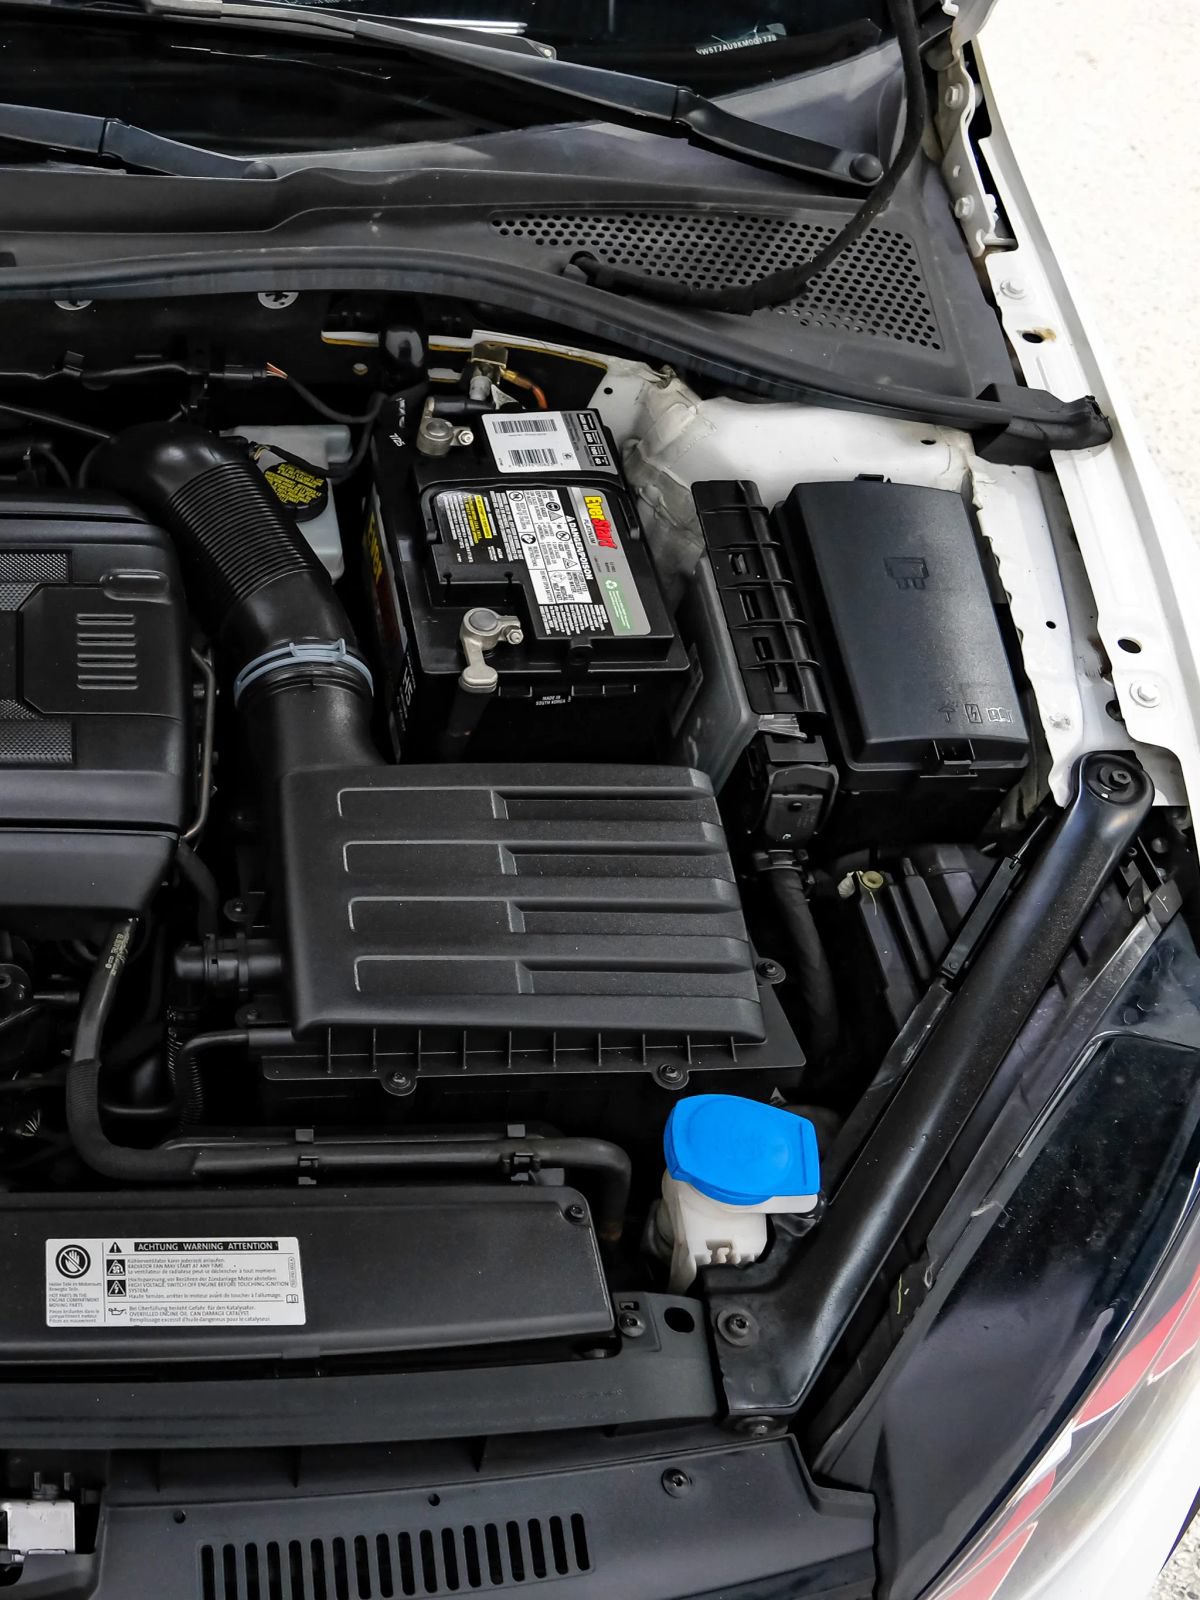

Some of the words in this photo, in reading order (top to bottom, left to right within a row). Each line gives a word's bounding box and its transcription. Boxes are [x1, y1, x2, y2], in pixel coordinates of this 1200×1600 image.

[581, 518, 597, 544] PLATINUM
[582, 495, 619, 549] EverStart
[566, 522, 595, 580] DANGER/POISON
[138, 1243, 179, 1251] ACHTUNG
[183, 1242, 224, 1250] WARNING
[228, 1242, 273, 1250] ATTENTION
